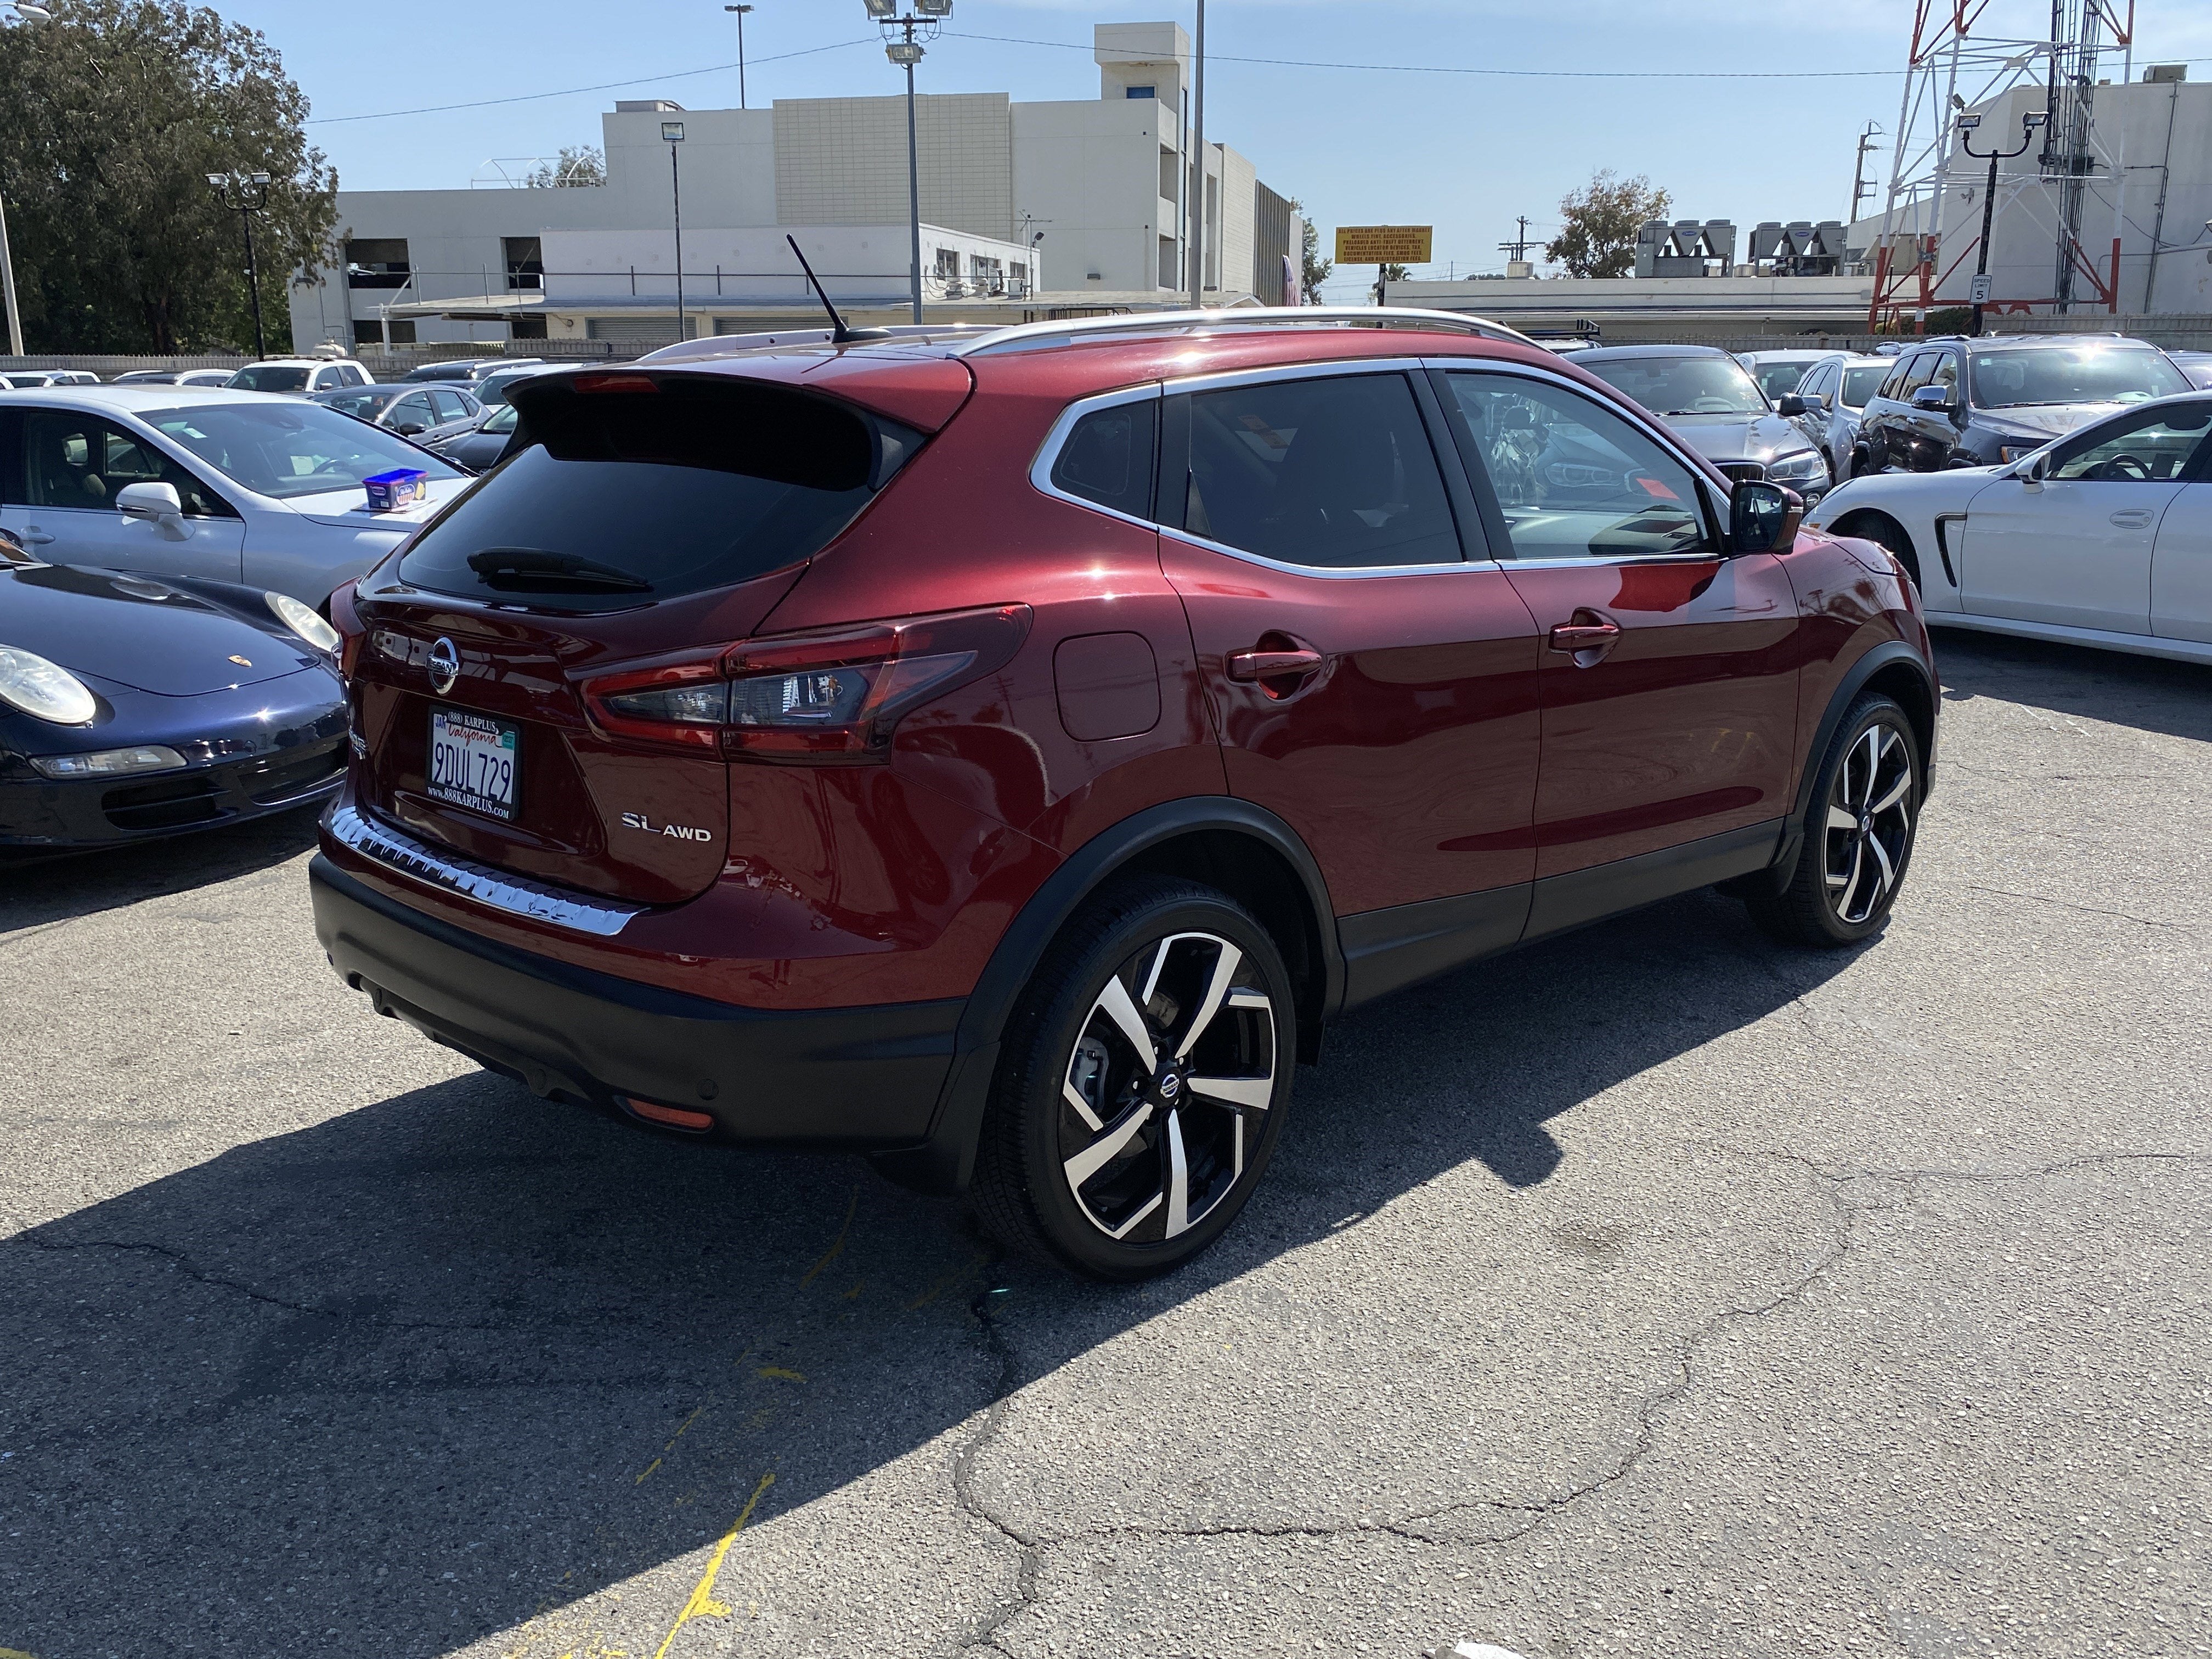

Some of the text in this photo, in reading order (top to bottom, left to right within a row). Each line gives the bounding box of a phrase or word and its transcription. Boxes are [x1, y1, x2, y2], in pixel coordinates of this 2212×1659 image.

[1976, 291, 1984, 300] 5
[448, 712, 496, 732] (888) KARPLUS
[448, 724, 503, 748] California
[434, 742, 511, 802] 9DUL729
[622, 812, 712, 842] SL AWD
